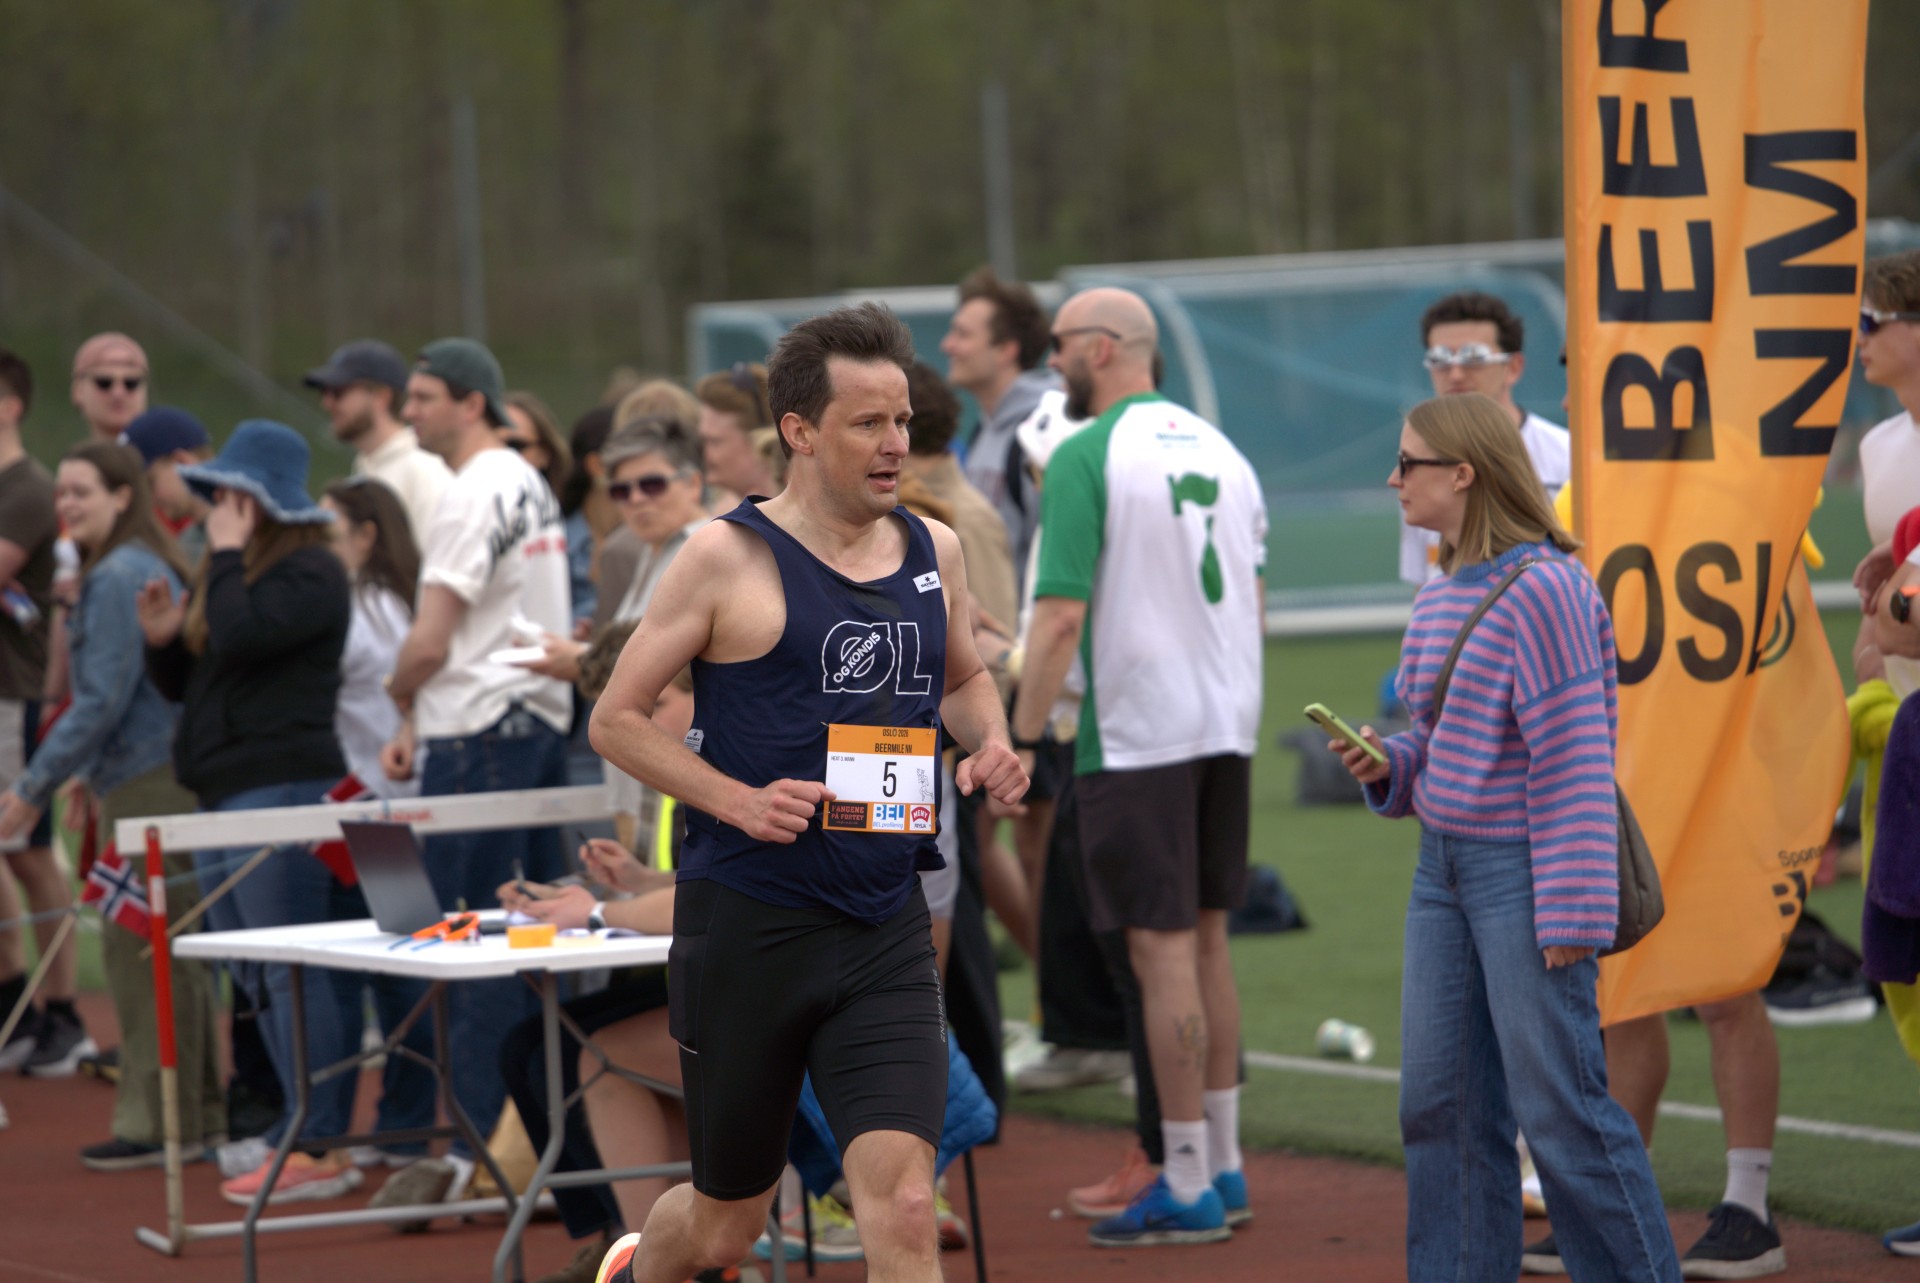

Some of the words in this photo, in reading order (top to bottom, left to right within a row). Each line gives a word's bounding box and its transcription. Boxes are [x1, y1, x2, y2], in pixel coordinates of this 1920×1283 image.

[1597, 0, 1715, 461] BEER
[1744, 129, 1857, 457] NM
[833, 665, 850, 683] OG
[847, 632, 881, 669] KONDIS
[882, 728, 897, 737] OSLO
[874, 742, 904, 753] BEERMILE
[883, 762, 897, 797] 5
[873, 803, 905, 820] BEL
[913, 809, 929, 819] MENY
